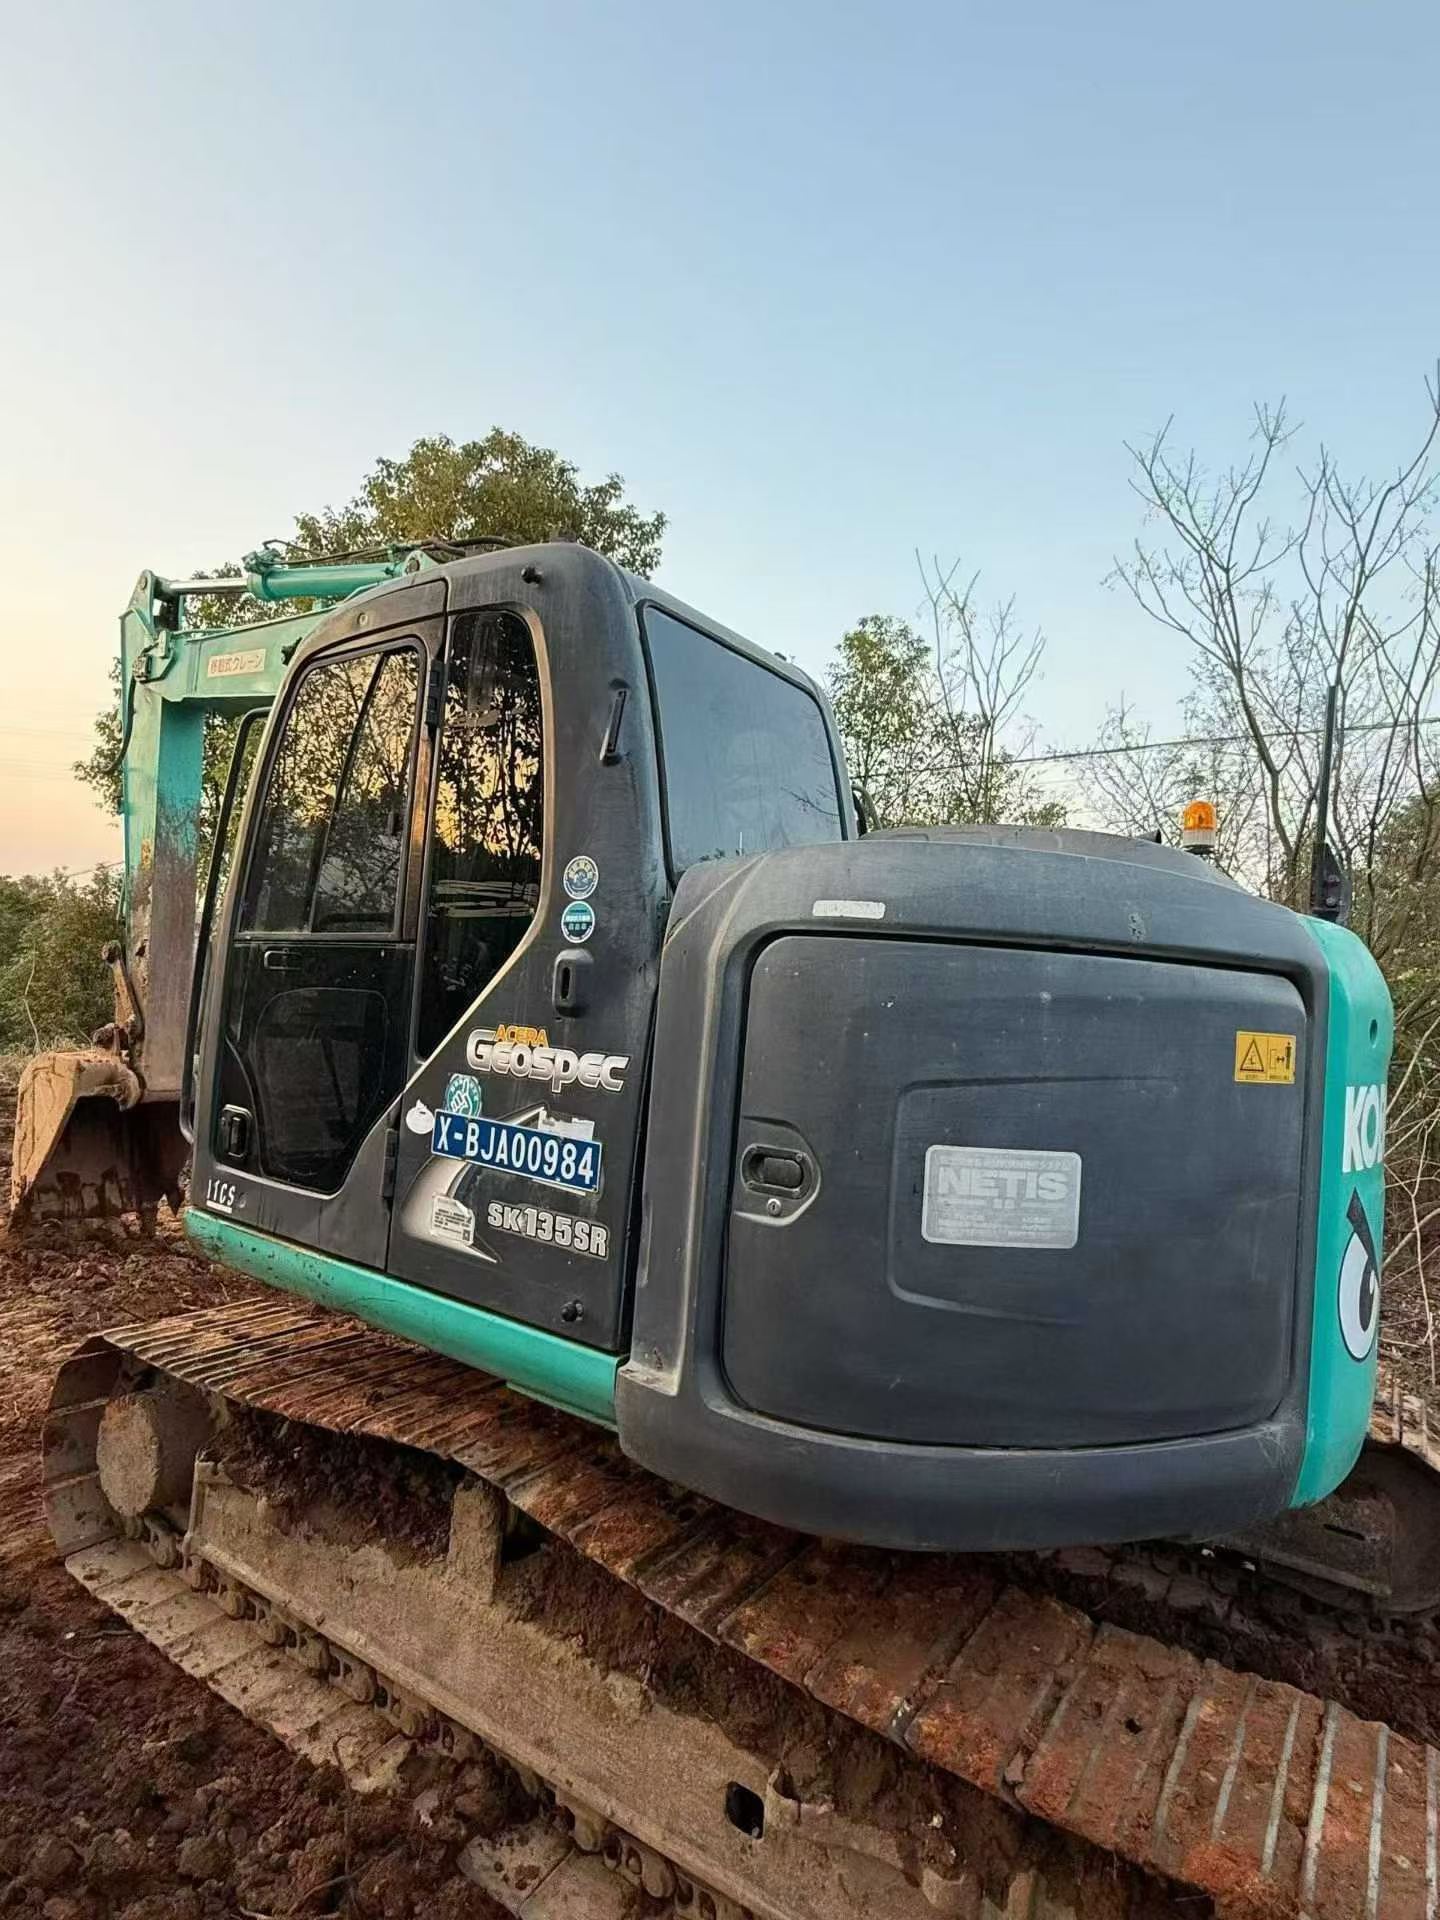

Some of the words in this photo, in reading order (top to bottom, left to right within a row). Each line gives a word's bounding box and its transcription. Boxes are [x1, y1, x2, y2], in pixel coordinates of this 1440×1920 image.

[496, 1024, 549, 1047] ACERA
[436, 1115, 595, 1185] X-BJA00984
[937, 1166, 1070, 1200] NETIS
[487, 1201, 609, 1258] SK135SR
